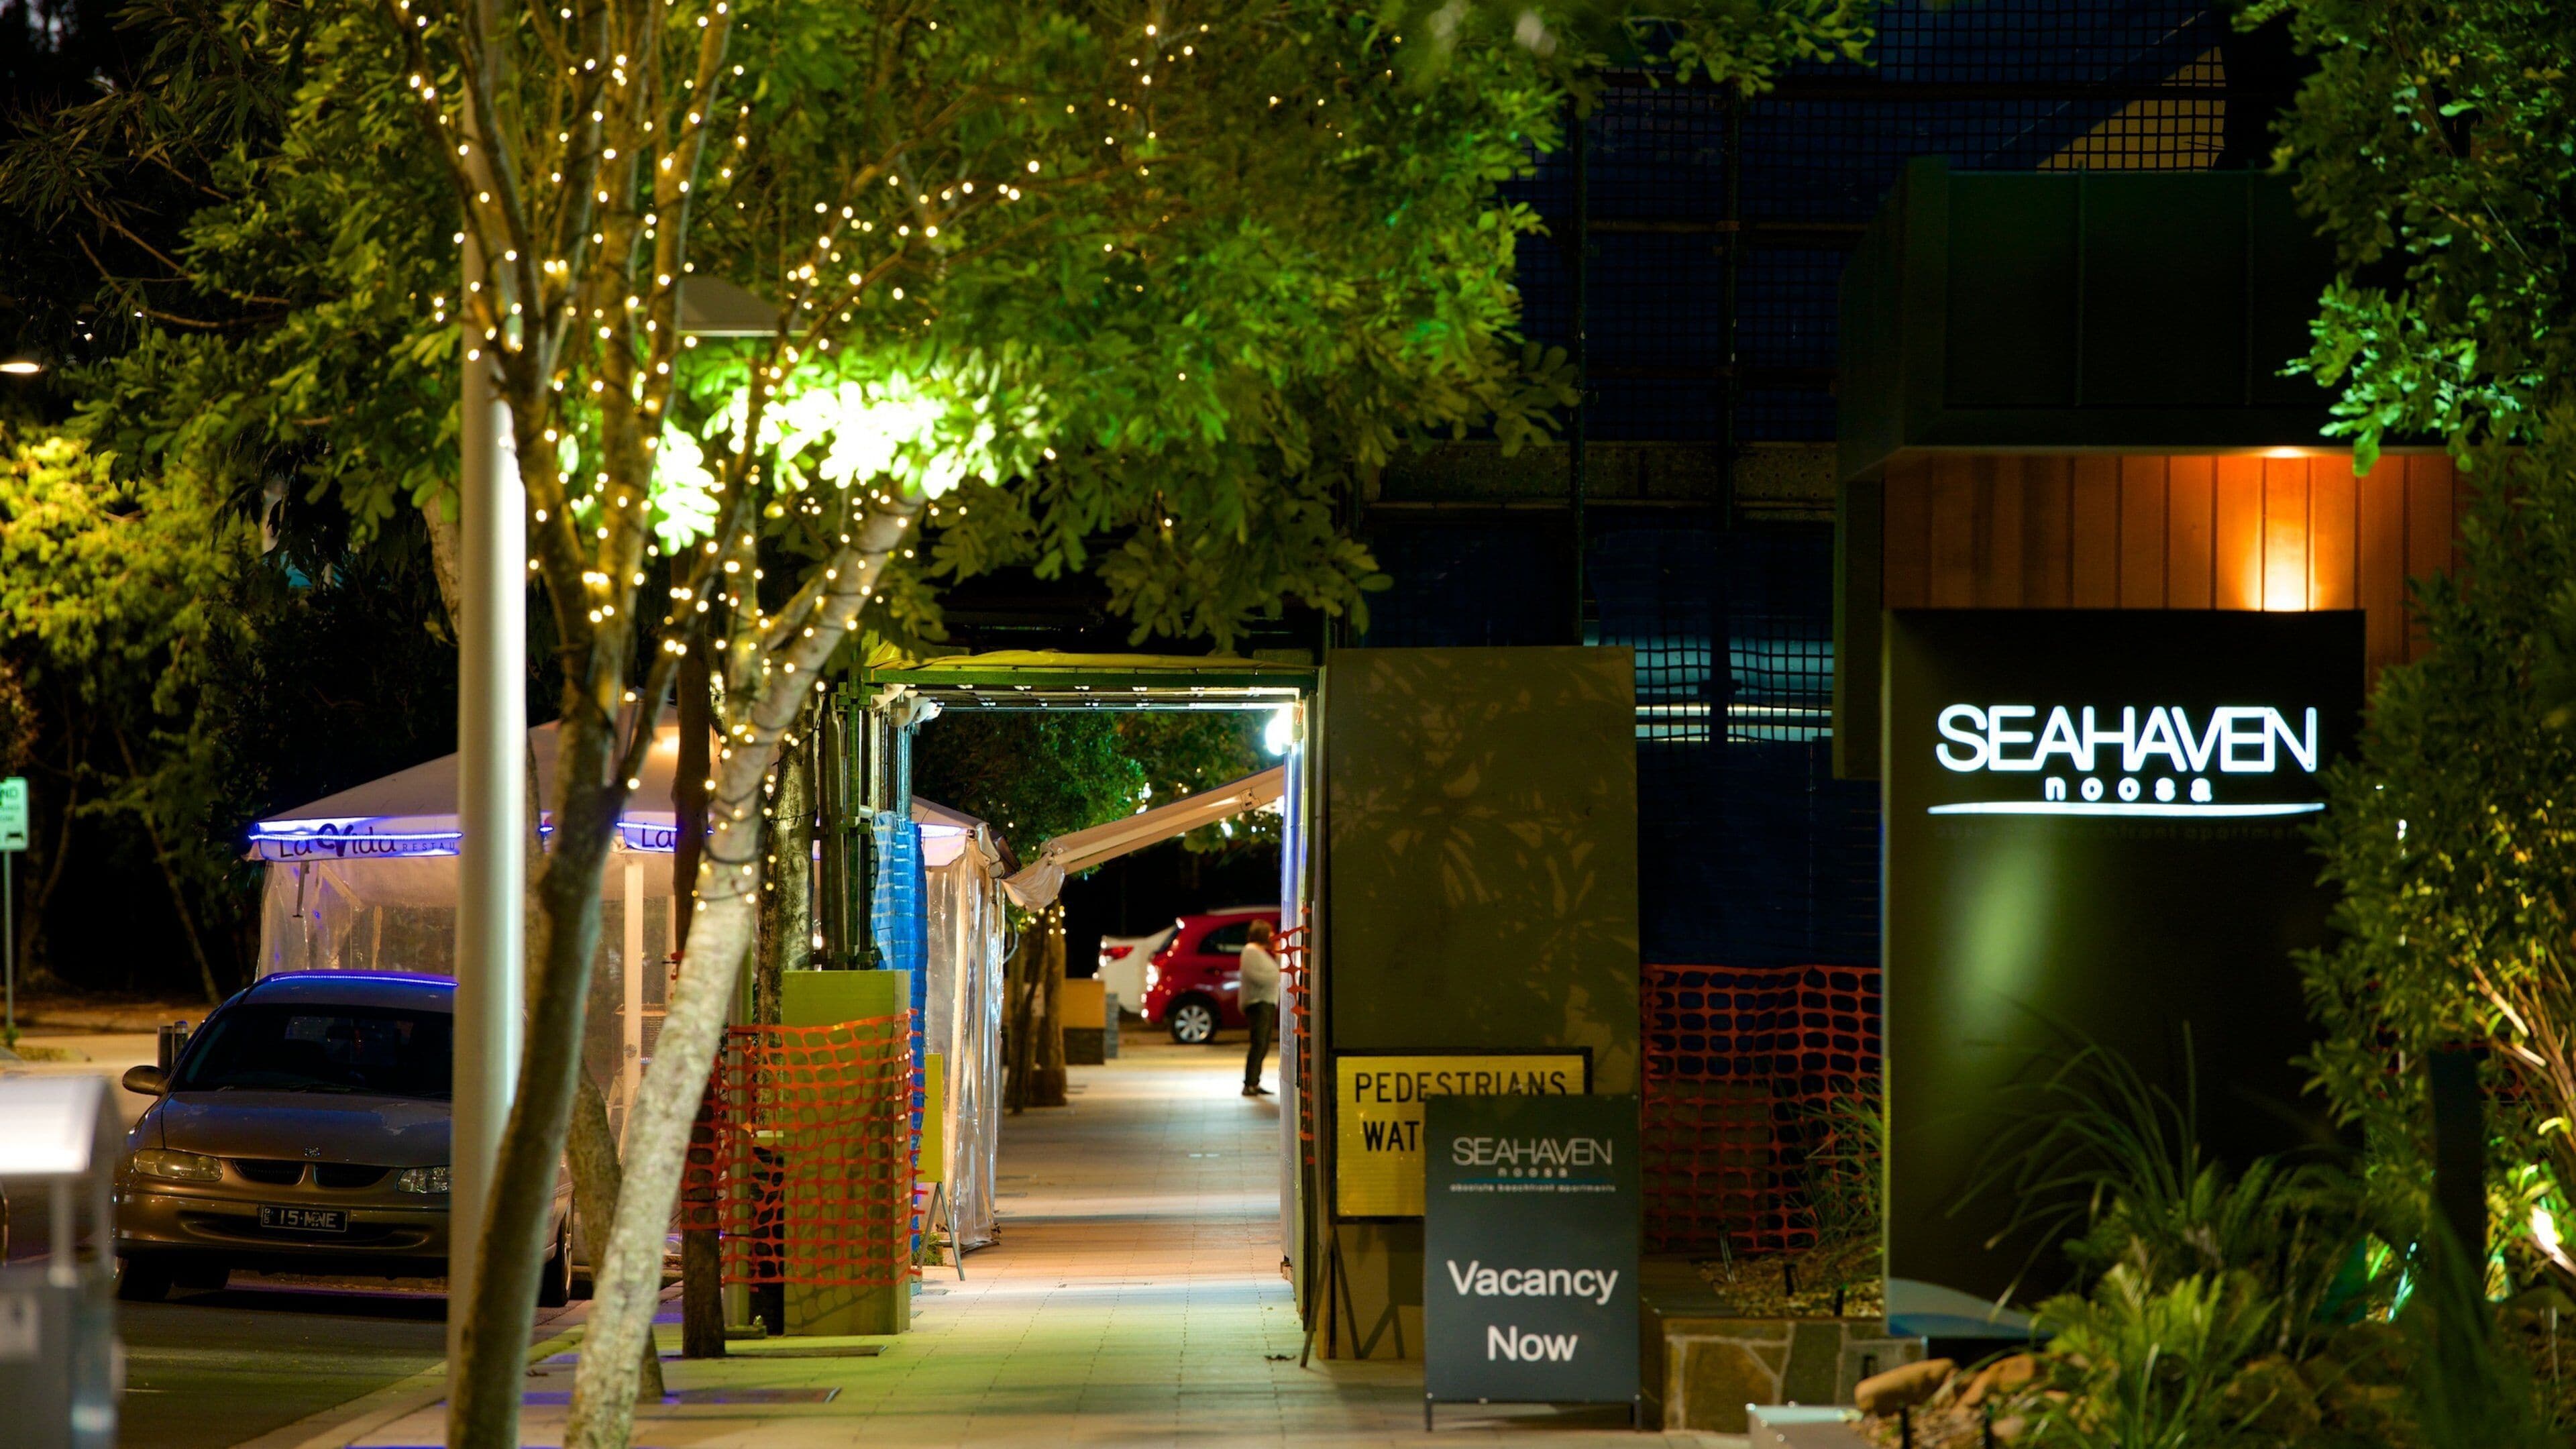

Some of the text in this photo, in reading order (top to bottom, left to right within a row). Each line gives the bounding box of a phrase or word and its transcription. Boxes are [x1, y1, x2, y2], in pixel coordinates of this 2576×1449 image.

[1935, 703, 2317, 773] SEAHAVEN
[2044, 777, 2212, 802] noosa
[402, 842, 456, 852] RESTAU
[1355, 1071, 1566, 1103] PEDESTRIANS
[1362, 1121, 1420, 1151] WAT
[1452, 1137, 1613, 1166] SEAHAVEN
[1447, 1260, 1618, 1305] Vacancy
[1487, 1325, 1578, 1362] Now
